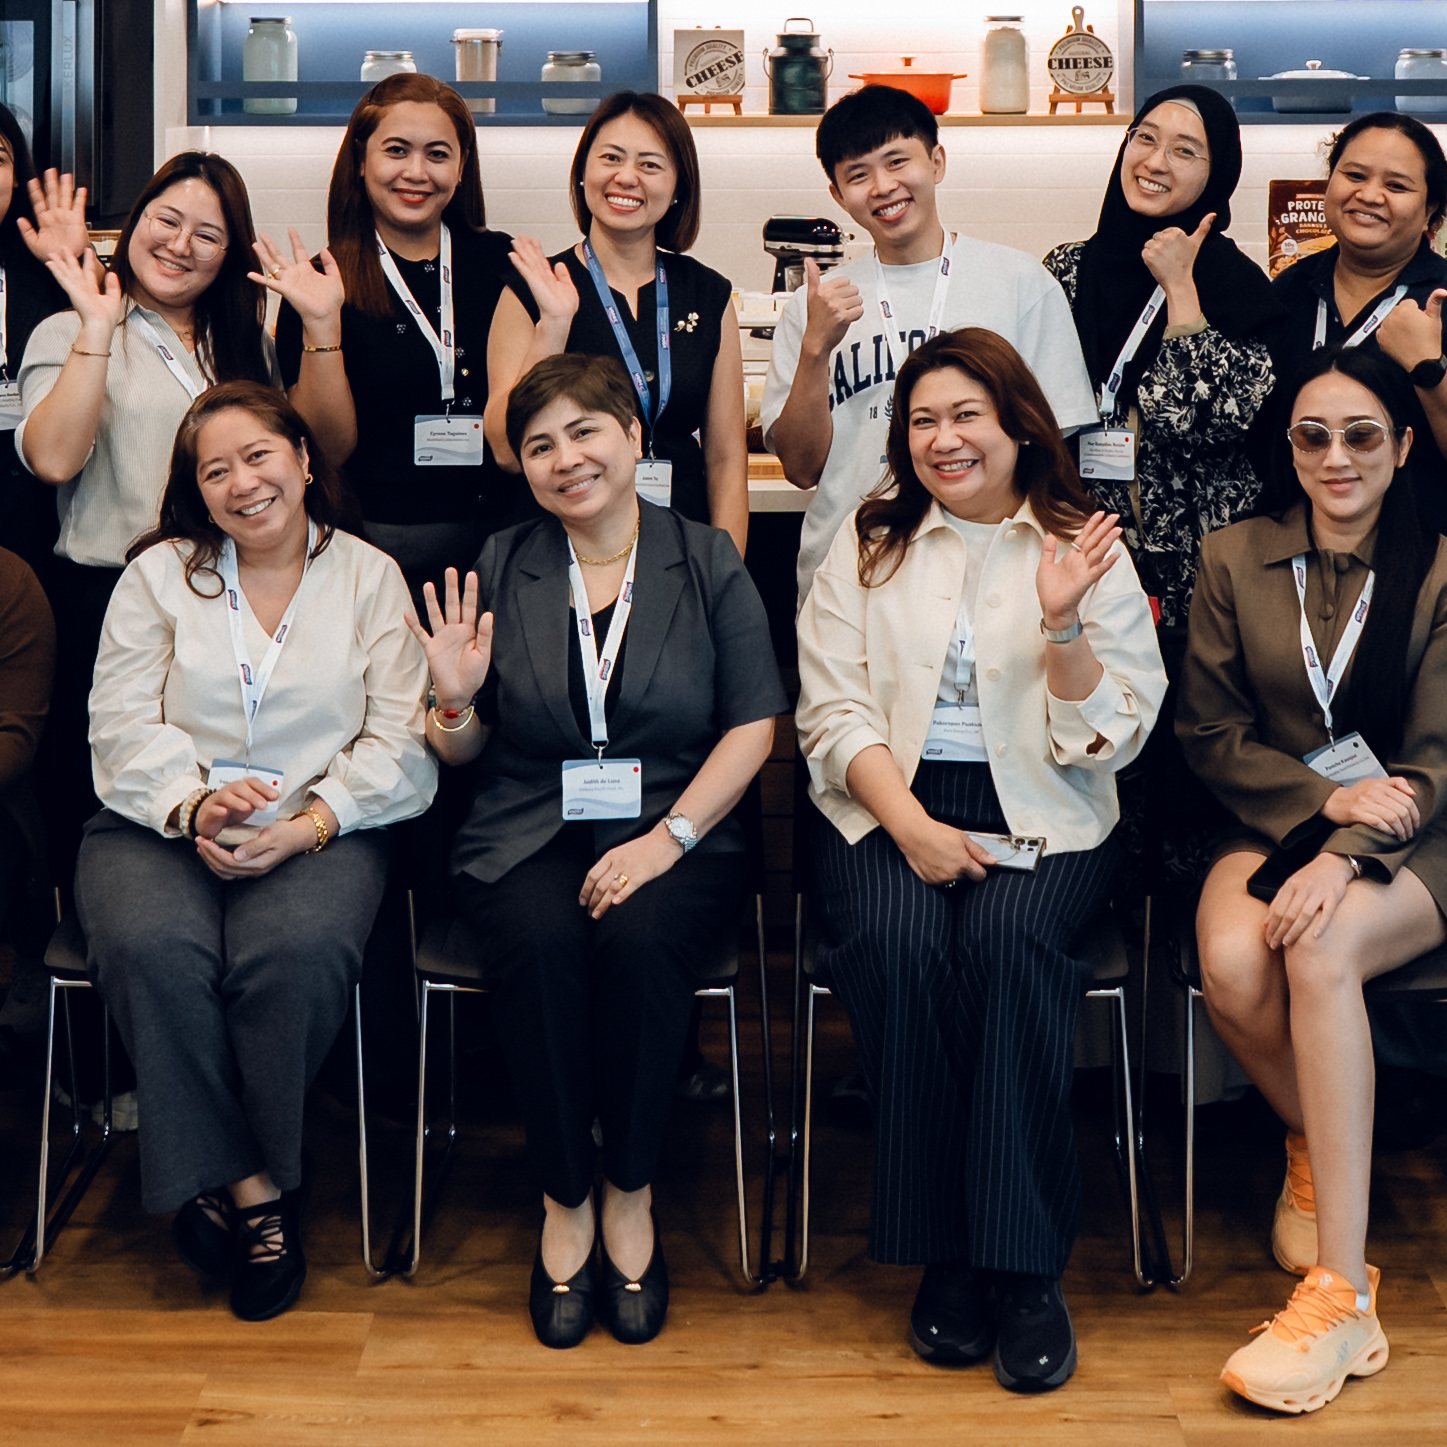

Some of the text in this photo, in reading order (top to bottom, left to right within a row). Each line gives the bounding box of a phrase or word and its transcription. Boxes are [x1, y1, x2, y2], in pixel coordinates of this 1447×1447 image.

[63, 35, 73, 95] AKERLUX
[685, 50, 745, 89] CHEESE
[1047, 56, 1114, 70] CHEESE
[1287, 200, 1325, 211] PROTE
[1280, 212, 1327, 224] GRANO
[607, 306, 619, 325] USDEC
[634, 373, 648, 392] USDEC
[869, 406, 878, 420] 18
